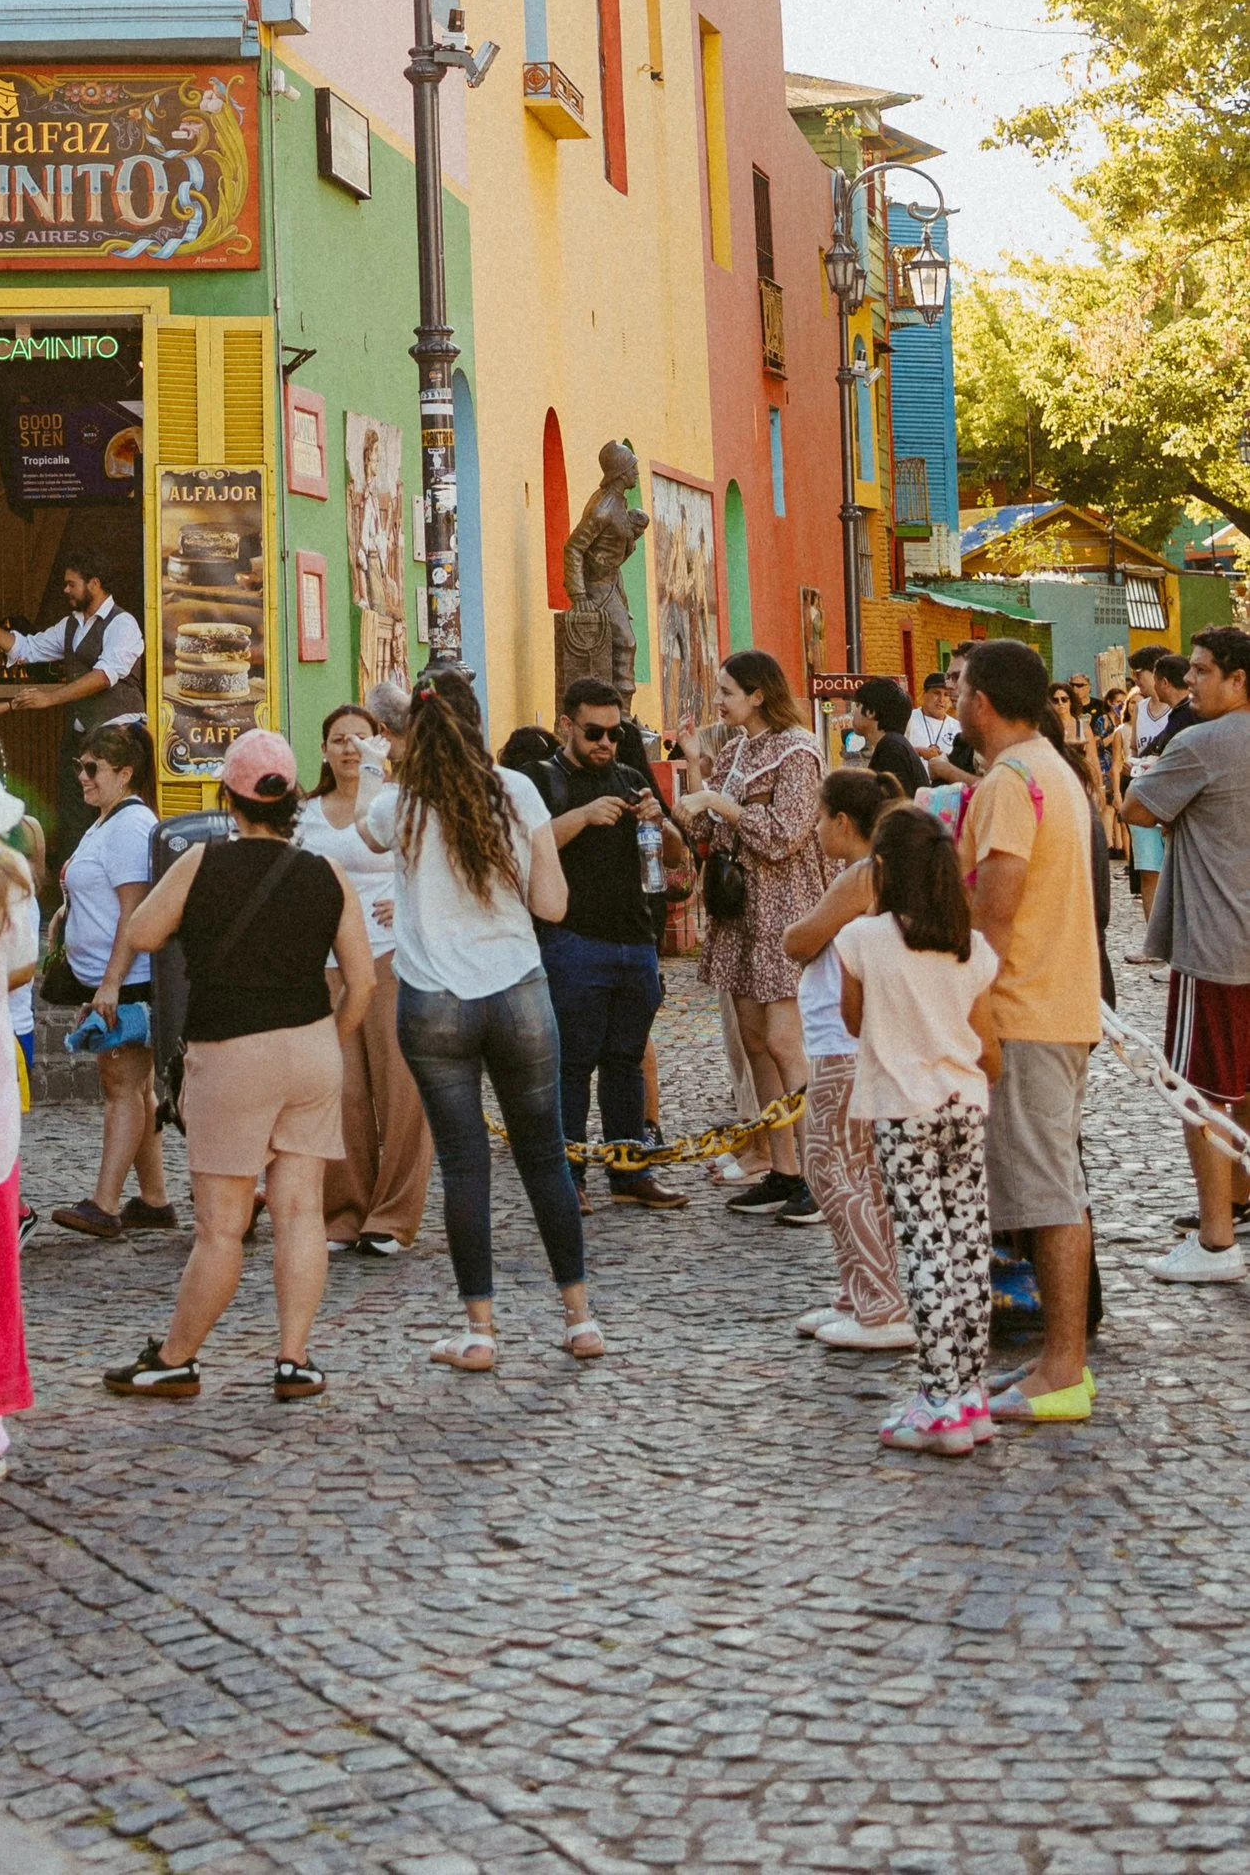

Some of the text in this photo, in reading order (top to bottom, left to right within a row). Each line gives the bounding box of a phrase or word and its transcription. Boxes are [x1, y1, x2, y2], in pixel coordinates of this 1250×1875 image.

[23, 230, 90, 243] AIRES
[19, 413, 62, 430] GOOD
[21, 455, 70, 467] Tropicalia
[169, 485, 257, 501] ALFAJOR
